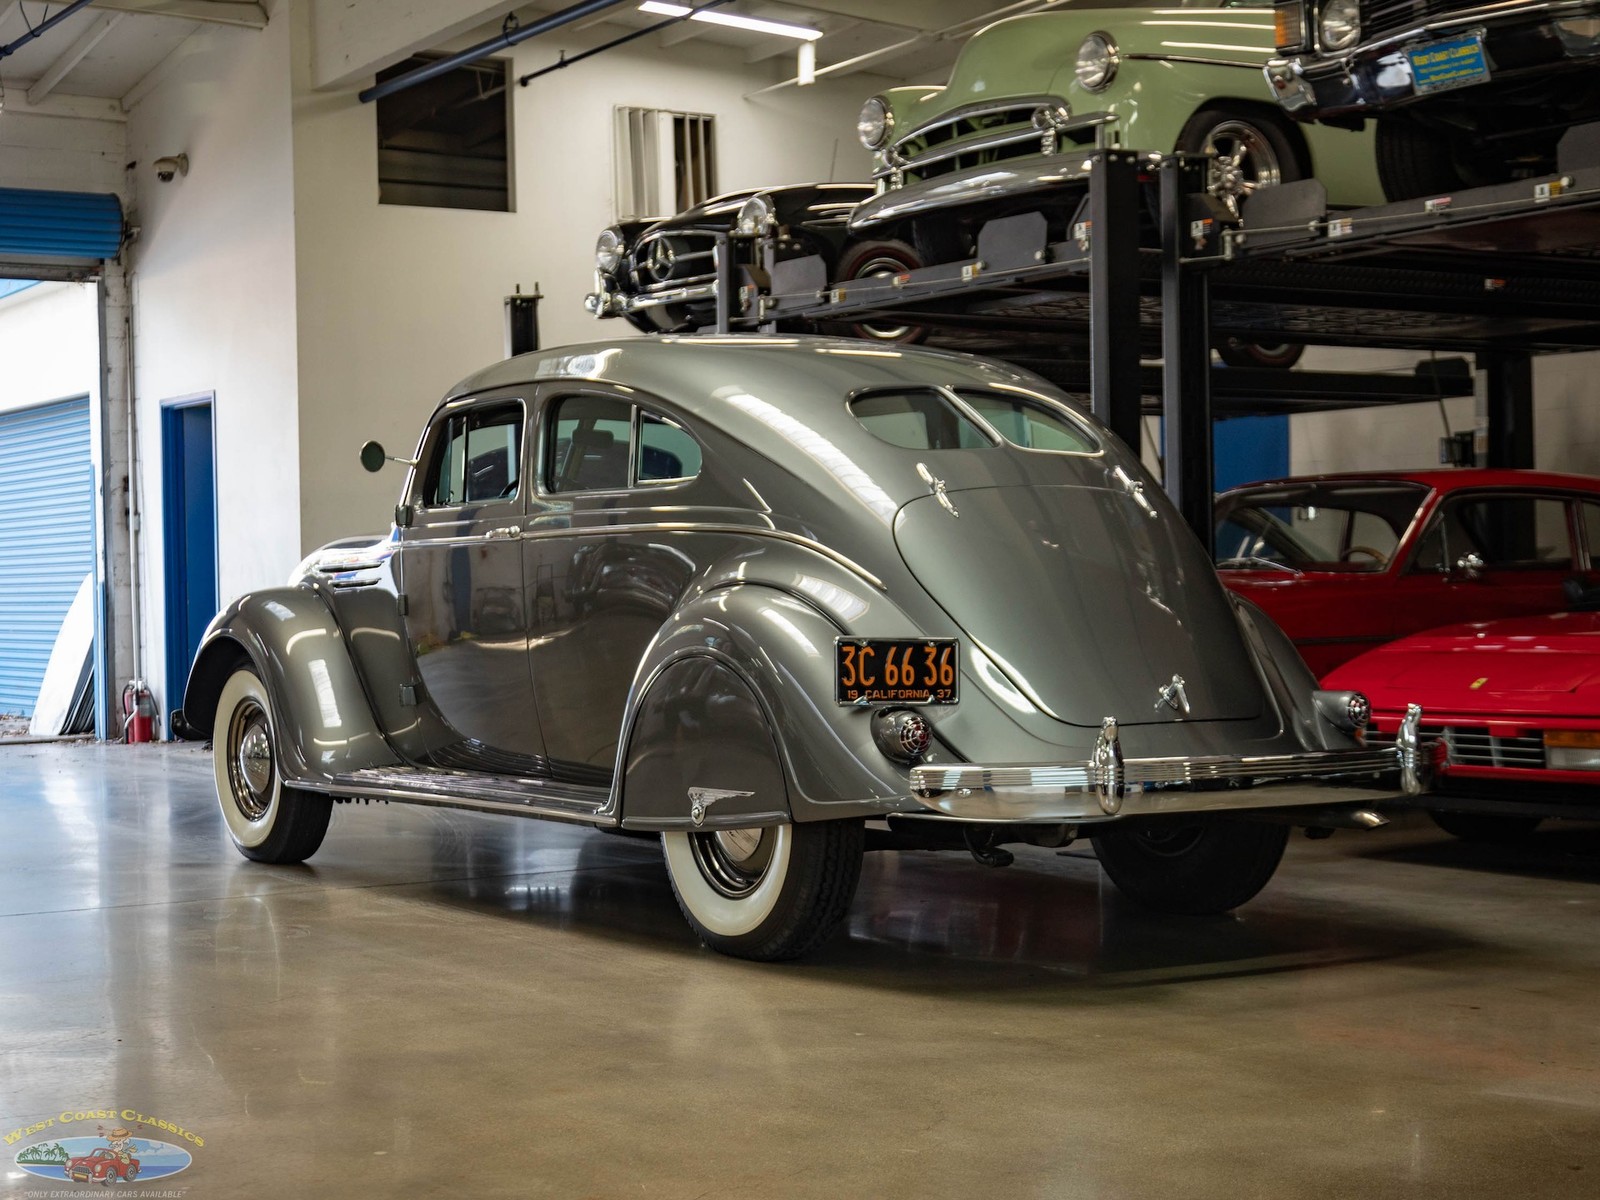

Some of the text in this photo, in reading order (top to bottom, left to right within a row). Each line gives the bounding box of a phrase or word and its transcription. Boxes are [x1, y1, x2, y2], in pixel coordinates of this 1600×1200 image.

[841, 645, 955, 687] 3C 66 36
[847, 688, 952, 700] 19 CALIFORNIA 37
